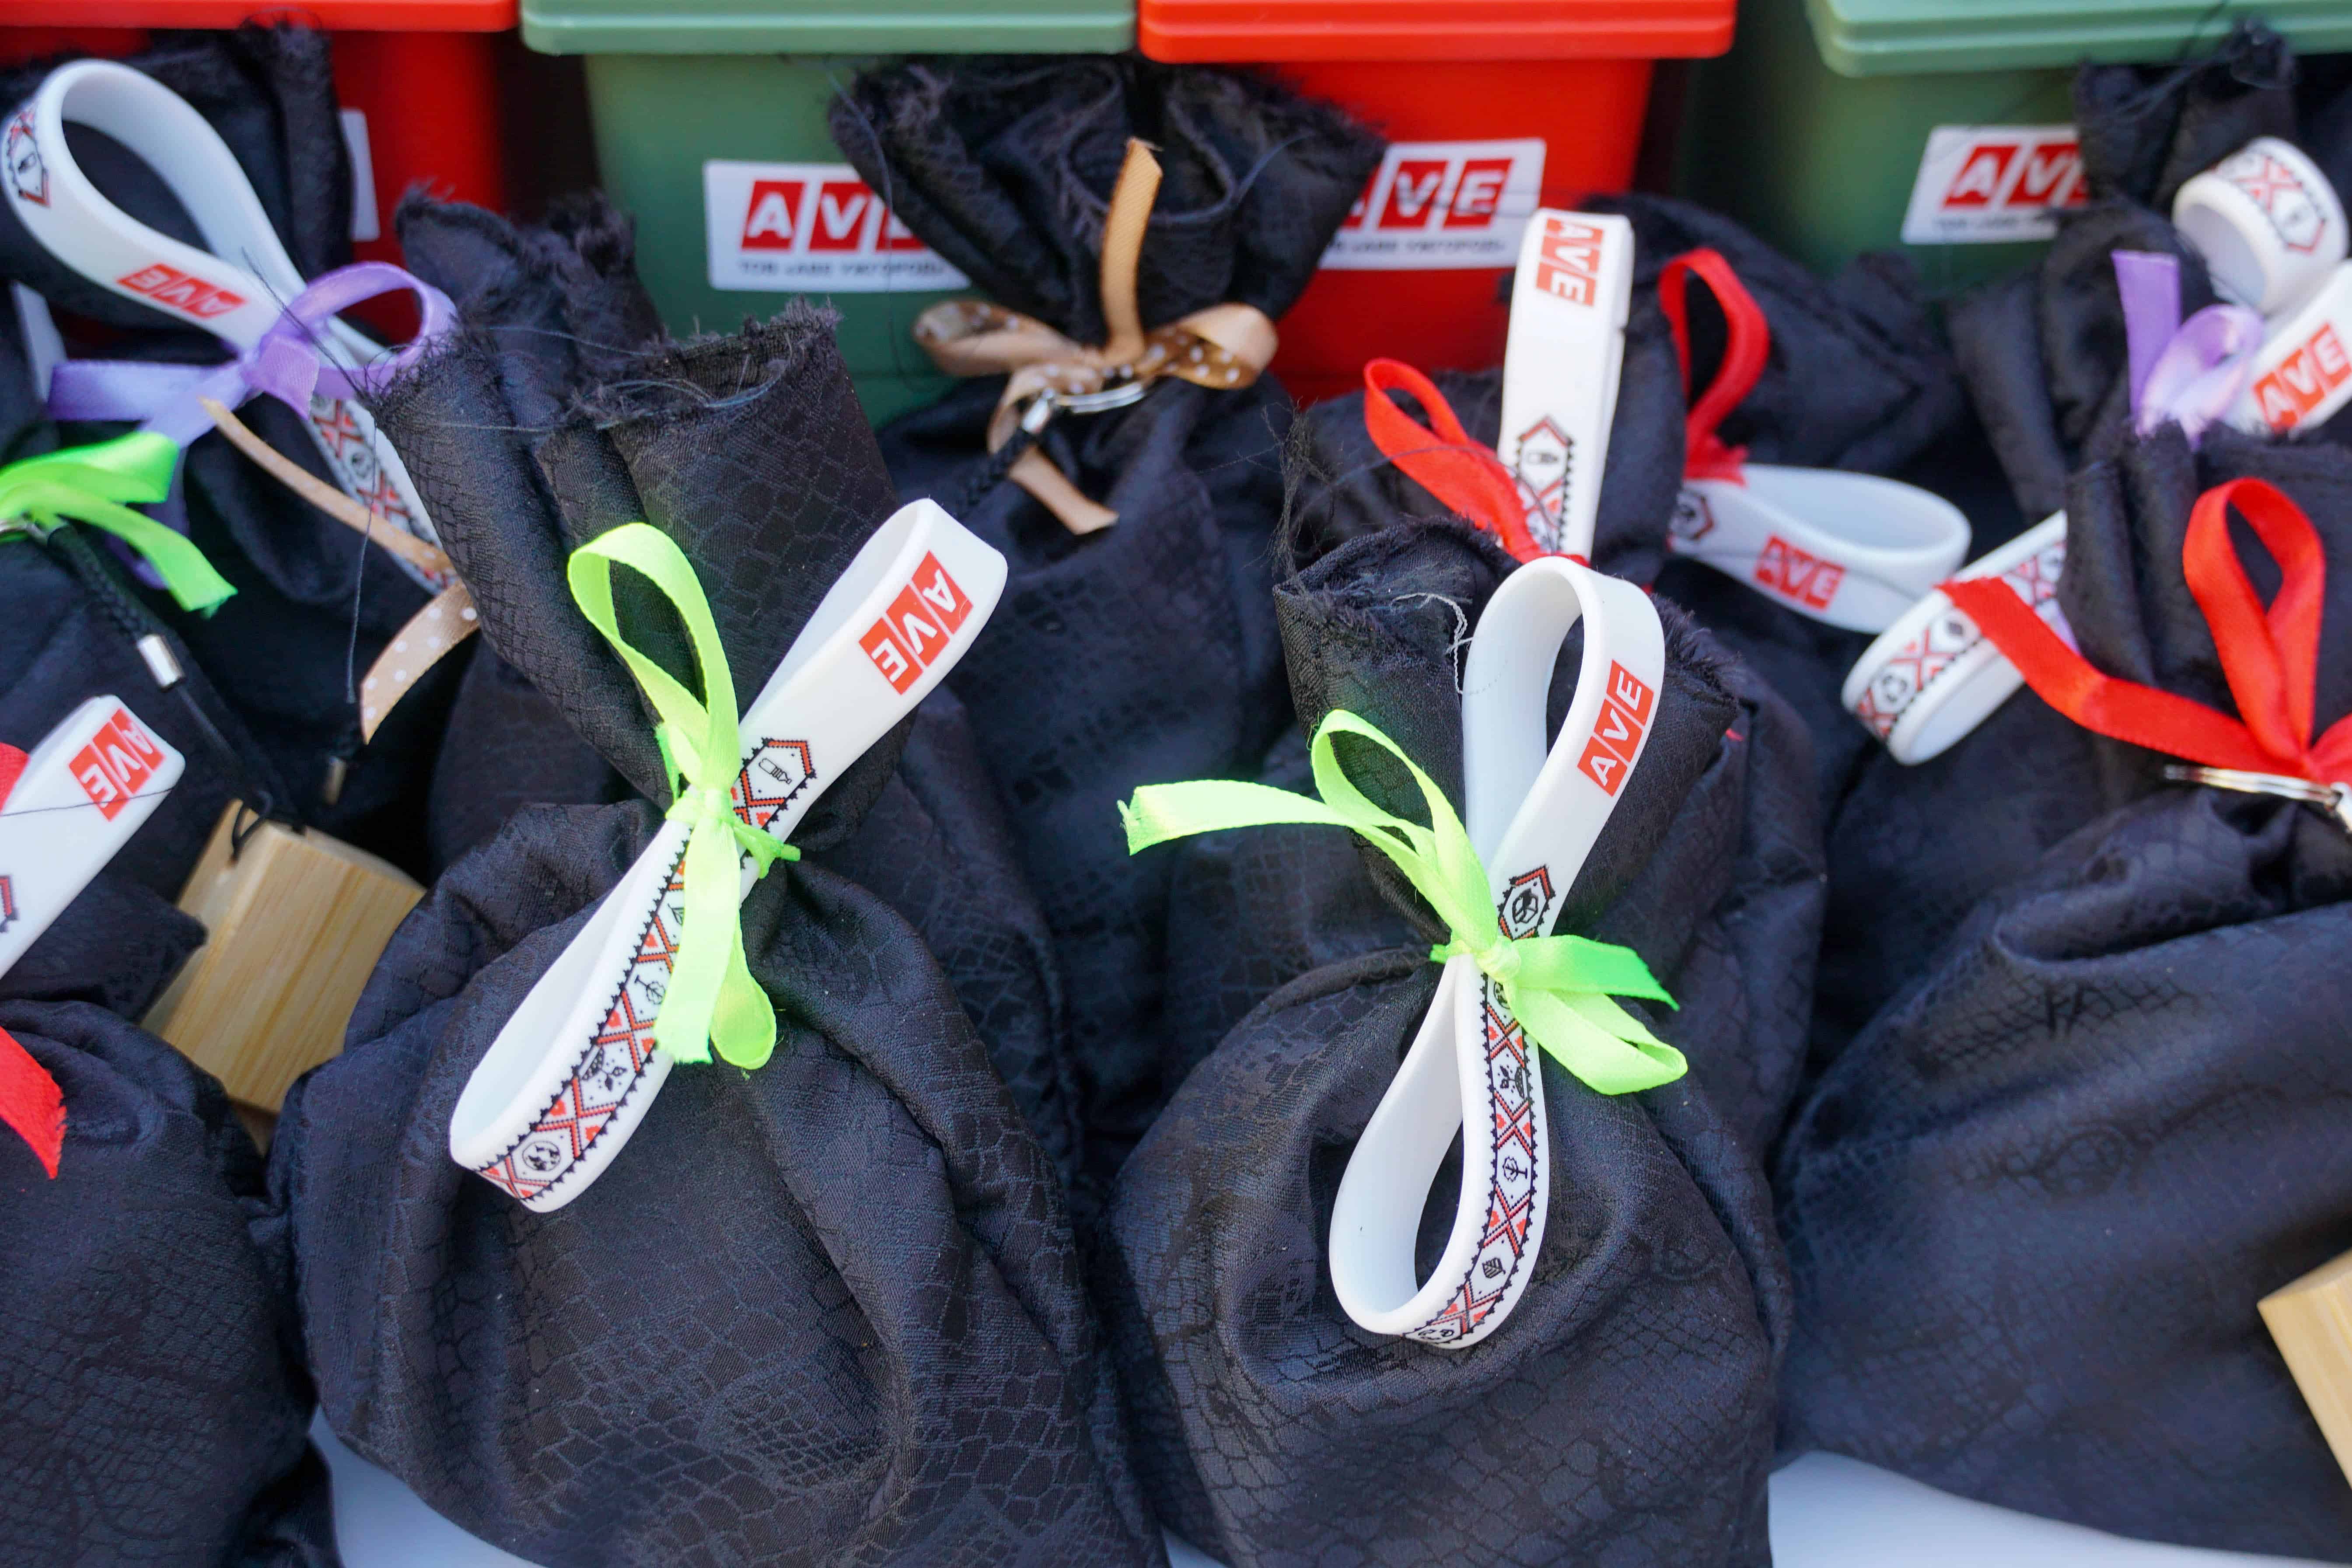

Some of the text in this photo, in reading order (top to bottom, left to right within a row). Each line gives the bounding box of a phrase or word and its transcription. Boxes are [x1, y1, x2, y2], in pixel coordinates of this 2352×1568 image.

[1351, 170, 1504, 217] VE
[1953, 152, 2086, 198] AV
[129, 269, 240, 312] AVE
[1549, 220, 1594, 303] AVE
[2262, 332, 2345, 423] AVE
[1761, 545, 1839, 599] AVE
[870, 568, 957, 683] AVE
[80, 723, 154, 808] AVE
[1590, 669, 1643, 787] AVE
